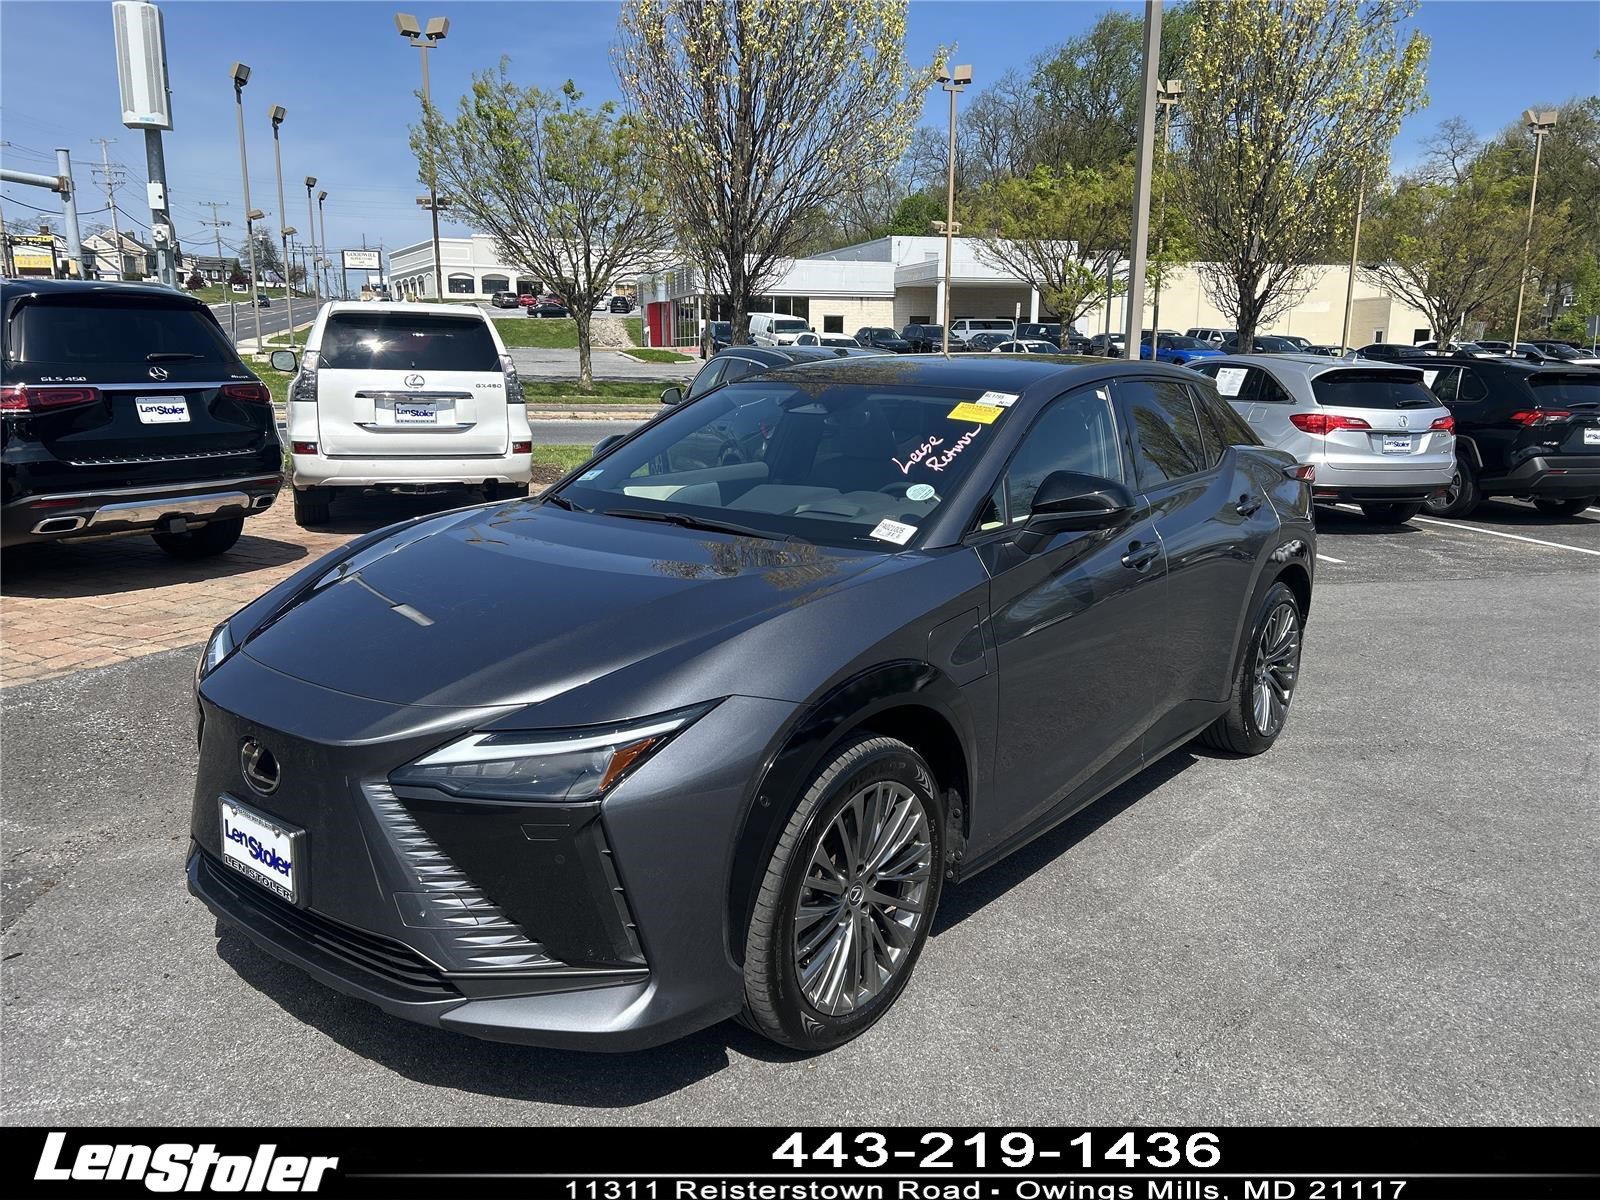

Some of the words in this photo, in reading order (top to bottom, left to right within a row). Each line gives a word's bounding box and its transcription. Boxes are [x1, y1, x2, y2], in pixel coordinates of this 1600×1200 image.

[140, 404, 185, 415] LenStoler
[396, 408, 435, 417] LenStoler
[225, 818, 292, 878] LenStoler
[225, 855, 247, 874] LEN
[248, 867, 292, 902] STOLER
